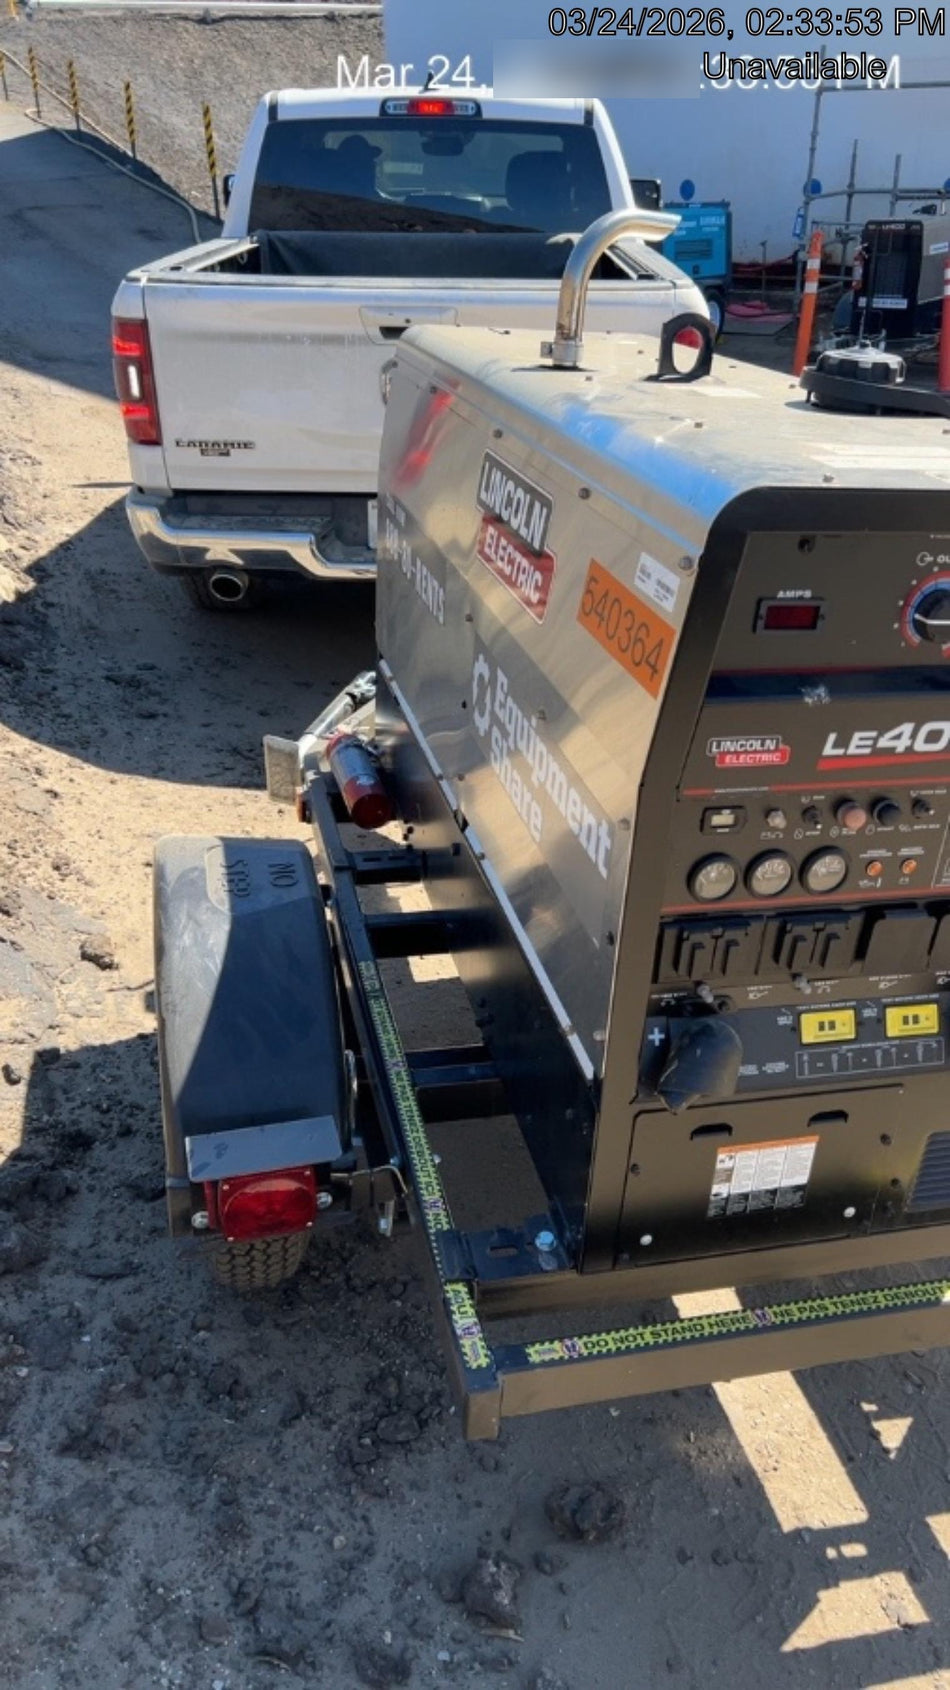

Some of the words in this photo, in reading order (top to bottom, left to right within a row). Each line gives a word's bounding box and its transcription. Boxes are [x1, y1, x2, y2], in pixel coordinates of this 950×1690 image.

[481, 460, 549, 552] LINCOLN
[483, 524, 543, 605] ELECTRIC
[777, 589, 812, 598] AMPS
[583, 575, 666, 683] 540364
[711, 739, 777, 752] LINCOLN
[724, 752, 782, 763] ELECTRIC
[821, 720, 950, 756] LE40
[489, 730, 544, 844] Share
[495, 666, 613, 880] Equipment
[267, 862, 299, 889] NO
[583, 1338, 609, 1352] DO
[613, 1331, 646, 1346] NOT
[650, 1322, 706, 1339] STAND
[707, 1314, 750, 1331] HERE
[773, 1308, 795, 1321] NE
[799, 1302, 829, 1316] PAS
[830, 1294, 880, 1311] TENEZ
[882, 1285, 945, 1302] DEBOUT
